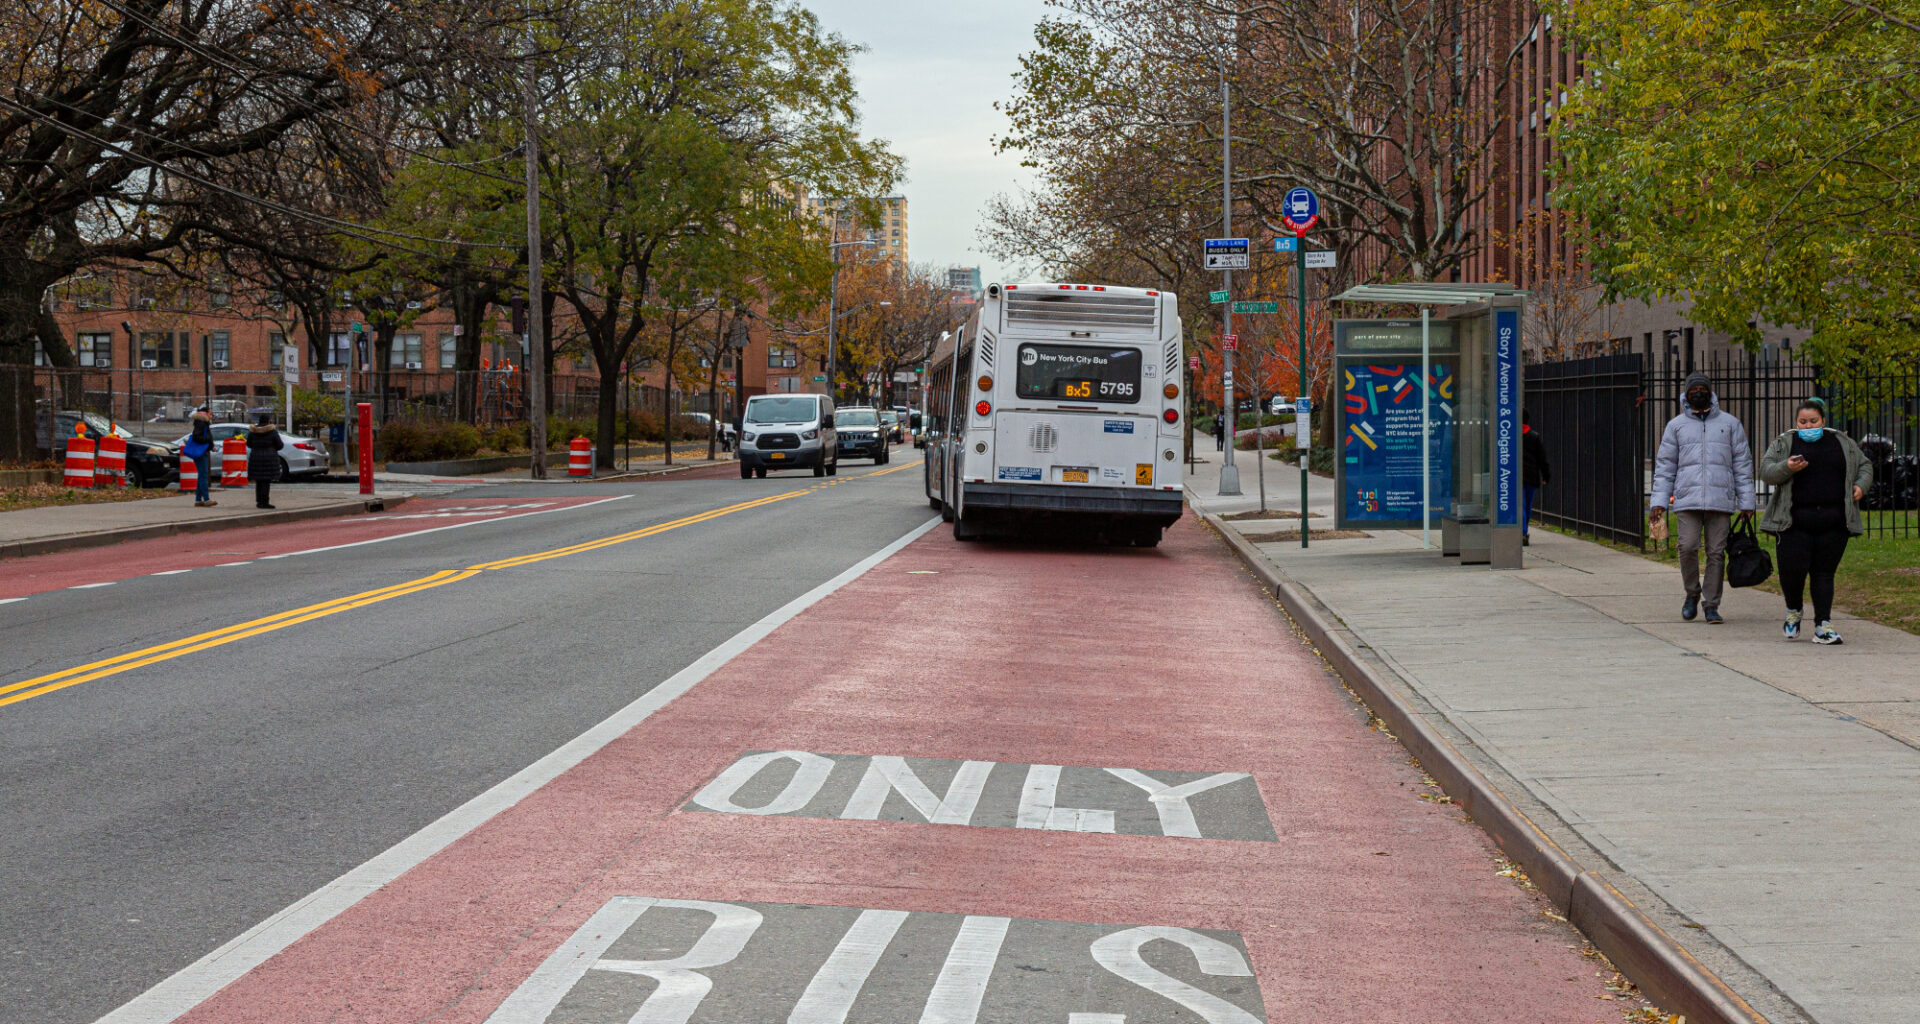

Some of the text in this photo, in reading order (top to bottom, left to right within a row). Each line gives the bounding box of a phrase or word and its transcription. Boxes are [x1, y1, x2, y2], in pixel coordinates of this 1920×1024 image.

[1276, 240, 1290, 249] Bx5
[1040, 353, 1108, 365] New York City Bus
[1065, 381, 1091, 398] Bx5
[1099, 382, 1134, 396] 5795
[1498, 327, 1511, 511] Story Avenue & Colgate Avenue
[1357, 488, 1378, 499] fuel
[1366, 500, 1378, 512] 50
[692, 750, 1252, 839] ONLY
